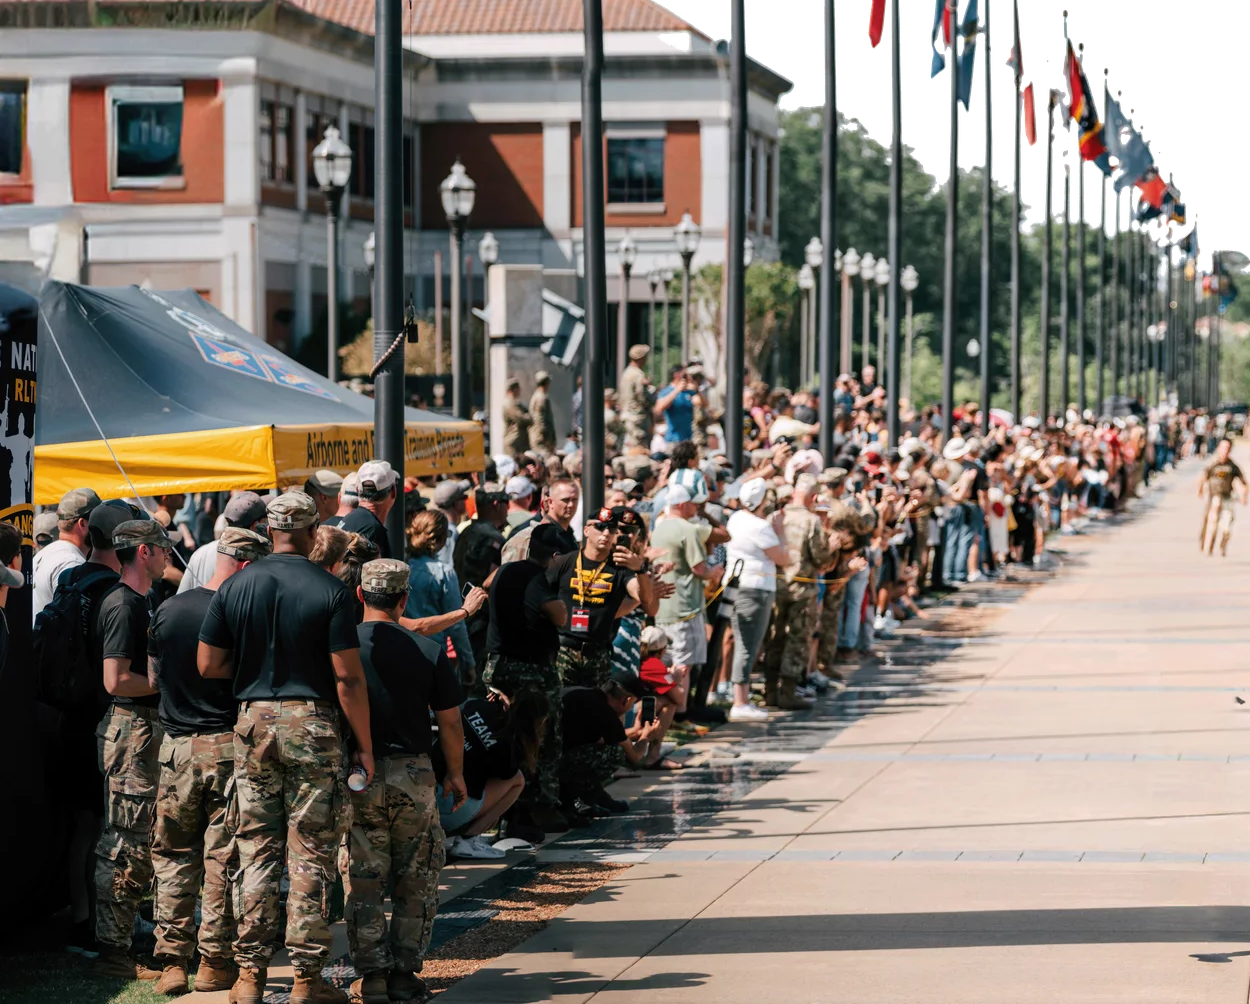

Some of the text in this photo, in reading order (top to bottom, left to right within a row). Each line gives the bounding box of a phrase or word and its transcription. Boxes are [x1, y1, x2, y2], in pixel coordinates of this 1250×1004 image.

[306, 429, 350, 468] Airborne
[352, 430, 369, 465] and
[467, 711, 498, 748] TEAM
